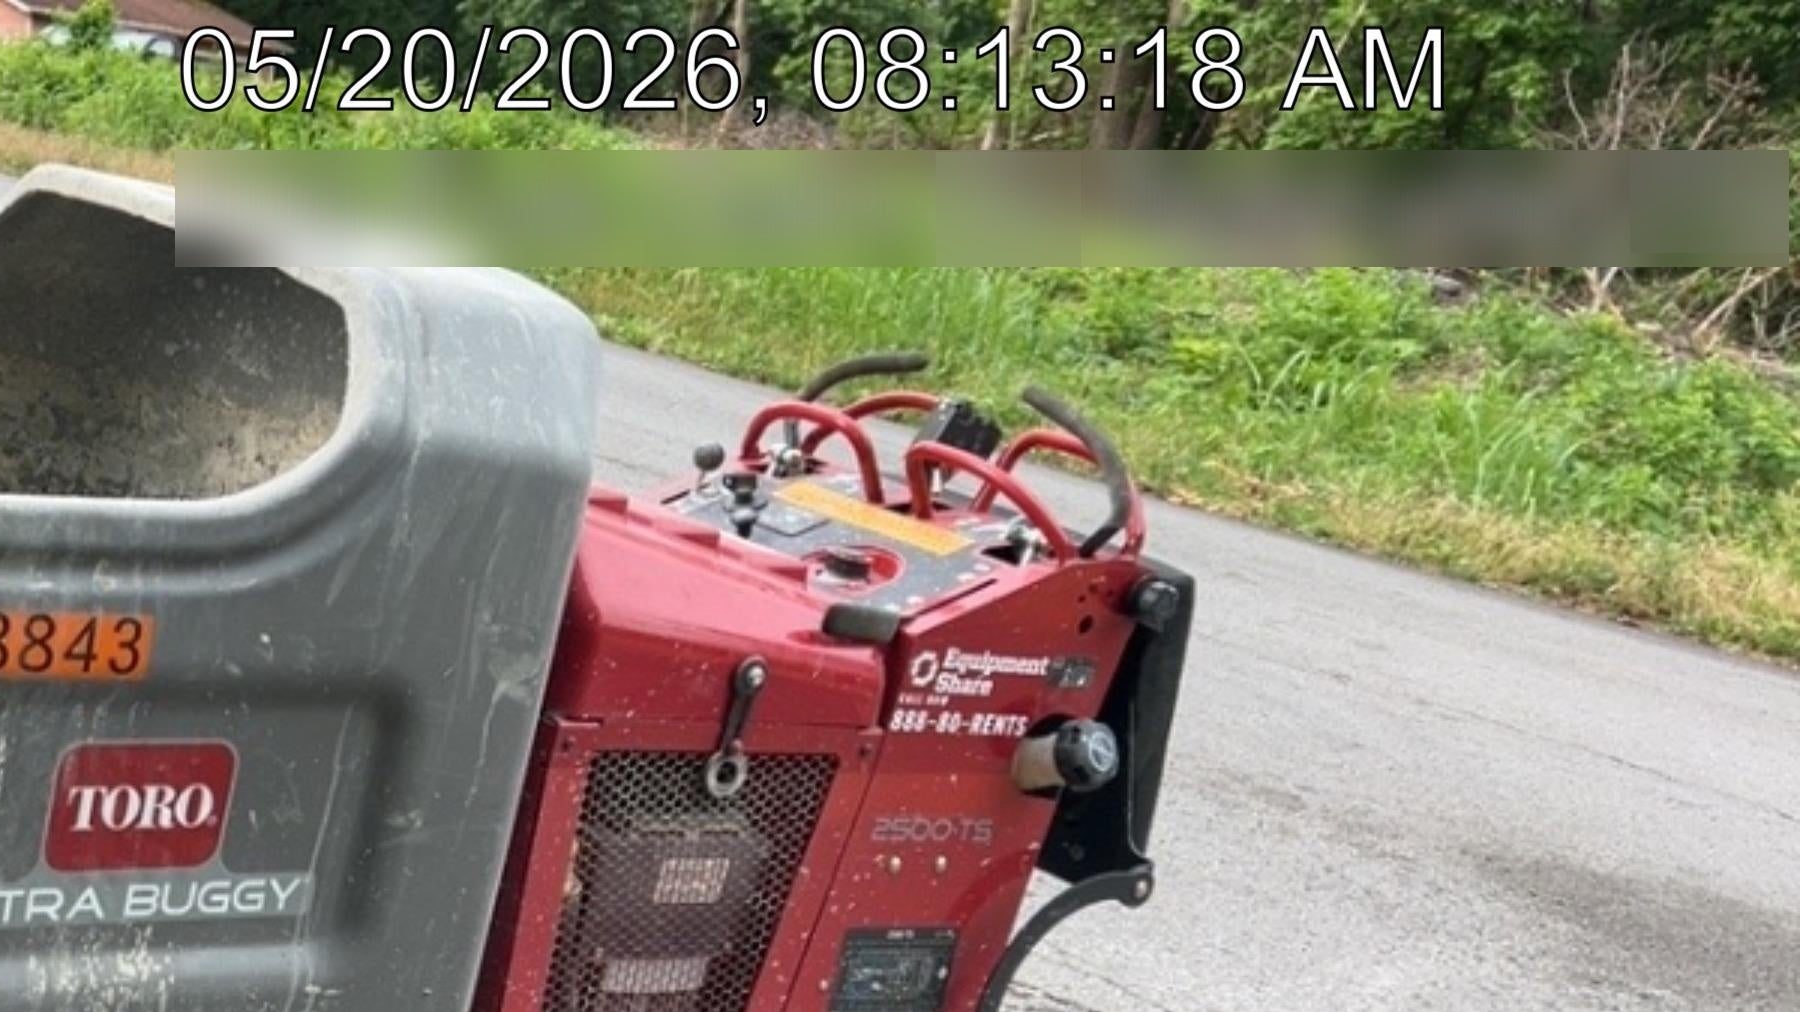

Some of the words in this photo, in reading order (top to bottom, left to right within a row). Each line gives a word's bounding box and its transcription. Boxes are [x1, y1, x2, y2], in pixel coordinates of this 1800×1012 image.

[943, 647, 1050, 676] Equipment
[935, 670, 994, 696] Share
[68, 784, 213, 832] TORO
[123, 878, 301, 917] BUGGY
